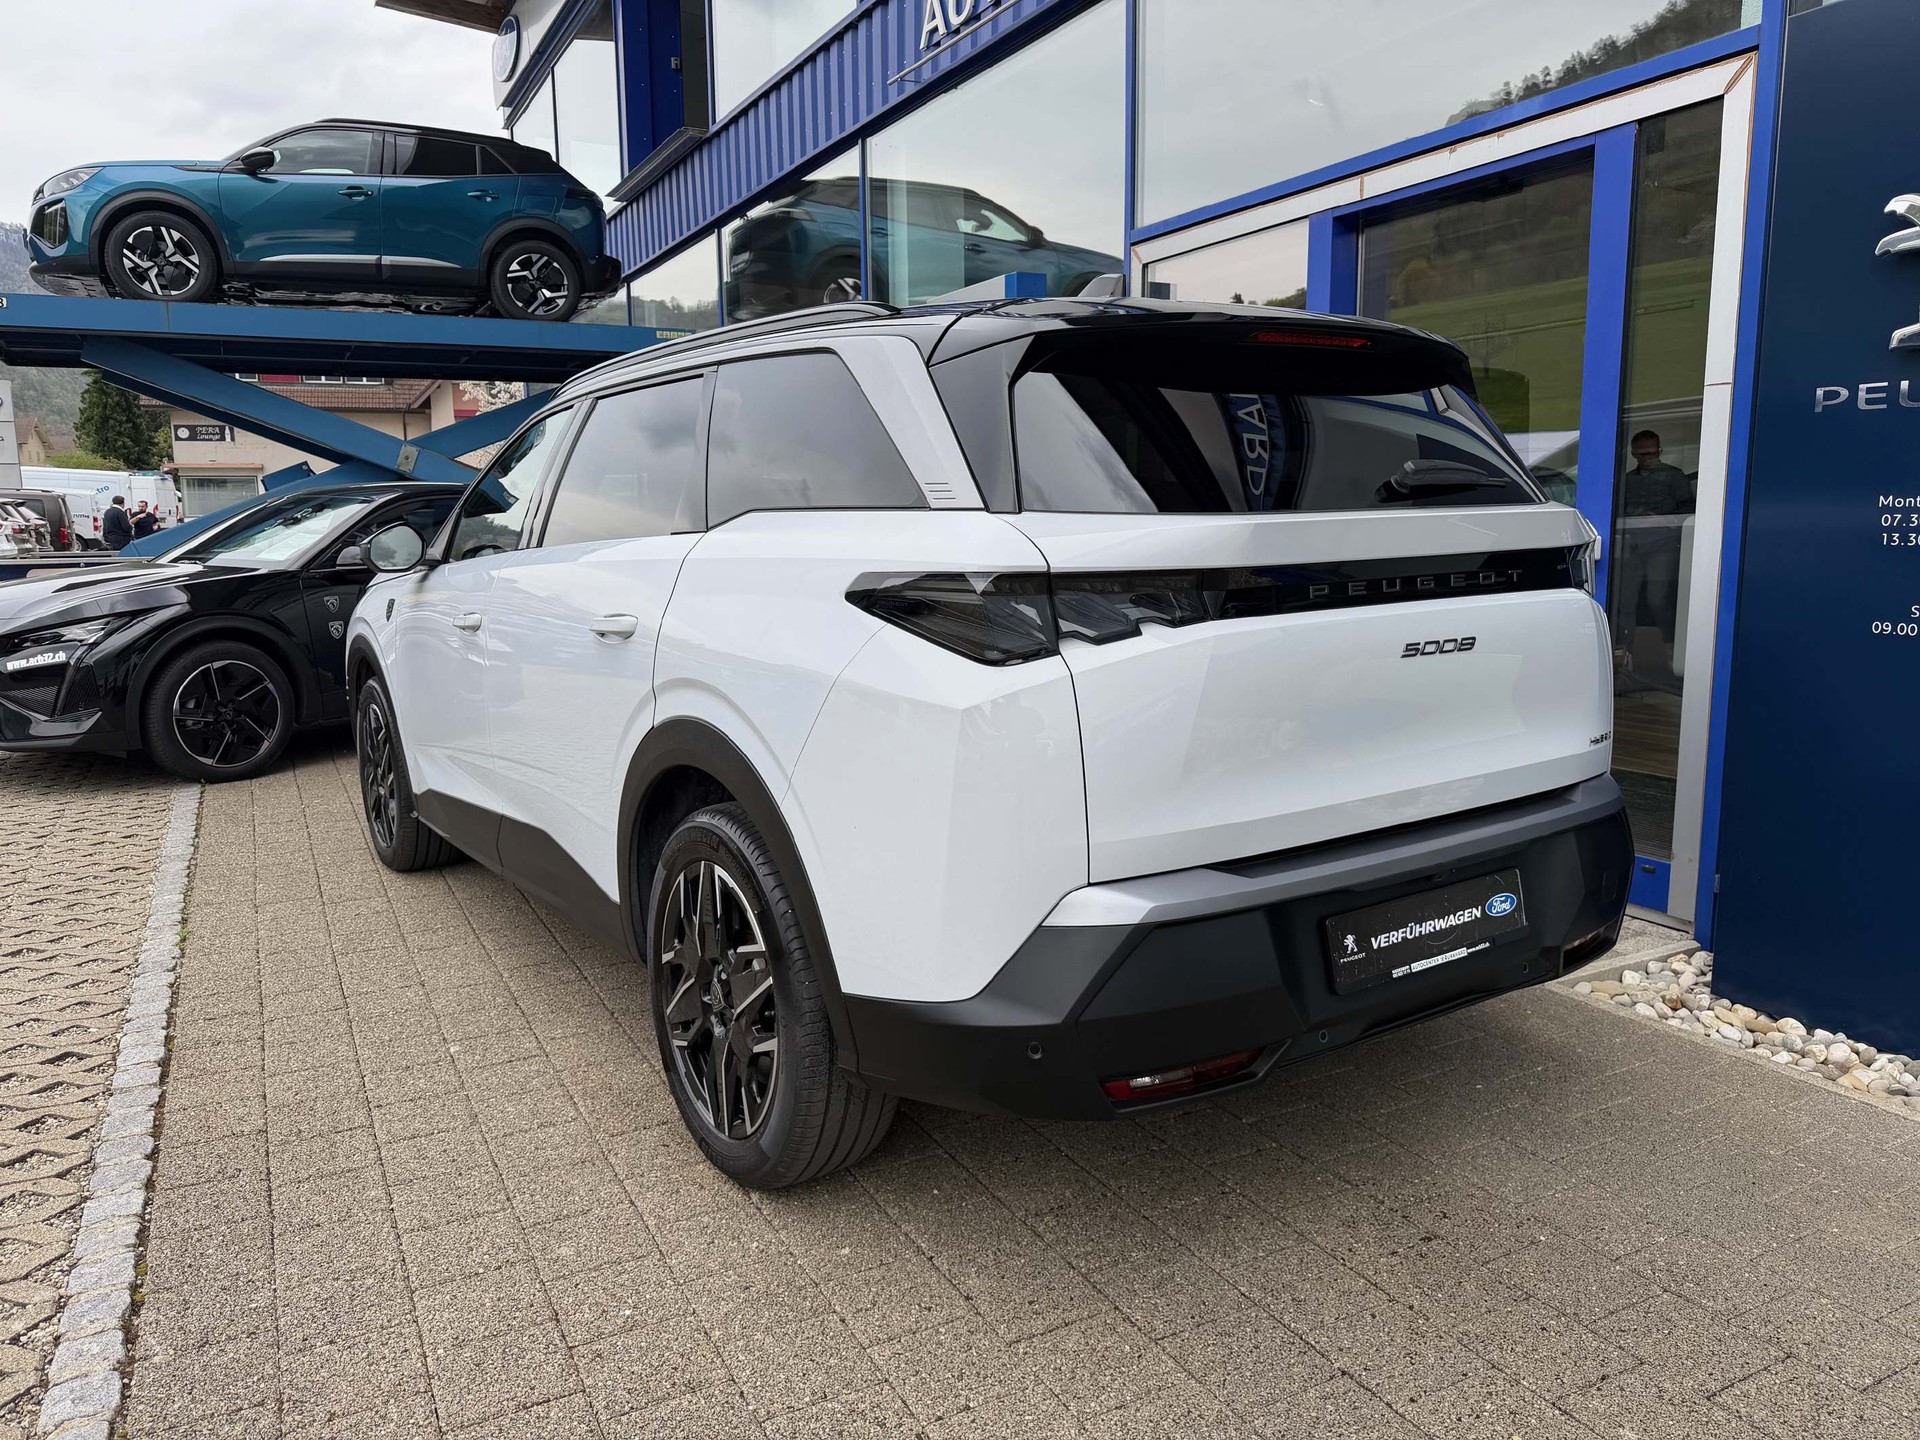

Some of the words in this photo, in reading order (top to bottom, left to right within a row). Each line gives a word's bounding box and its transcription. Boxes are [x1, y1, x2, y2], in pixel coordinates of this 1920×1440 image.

[919, 0, 996, 50] AU
[1814, 380, 1920, 412] PEU
[197, 433, 221, 441] Lounge
[96, 484, 110, 495] tro
[1881, 513, 1920, 527] 07.3
[1882, 532, 1920, 546] 13.3
[1309, 569, 1523, 599] PEUGEOT
[1871, 621, 1918, 636] 09.00
[1400, 636, 1477, 658] 5008
[1370, 905, 1482, 950] VERFÜHRWAGEN
[1340, 952, 1366, 964] PEUGEOT
